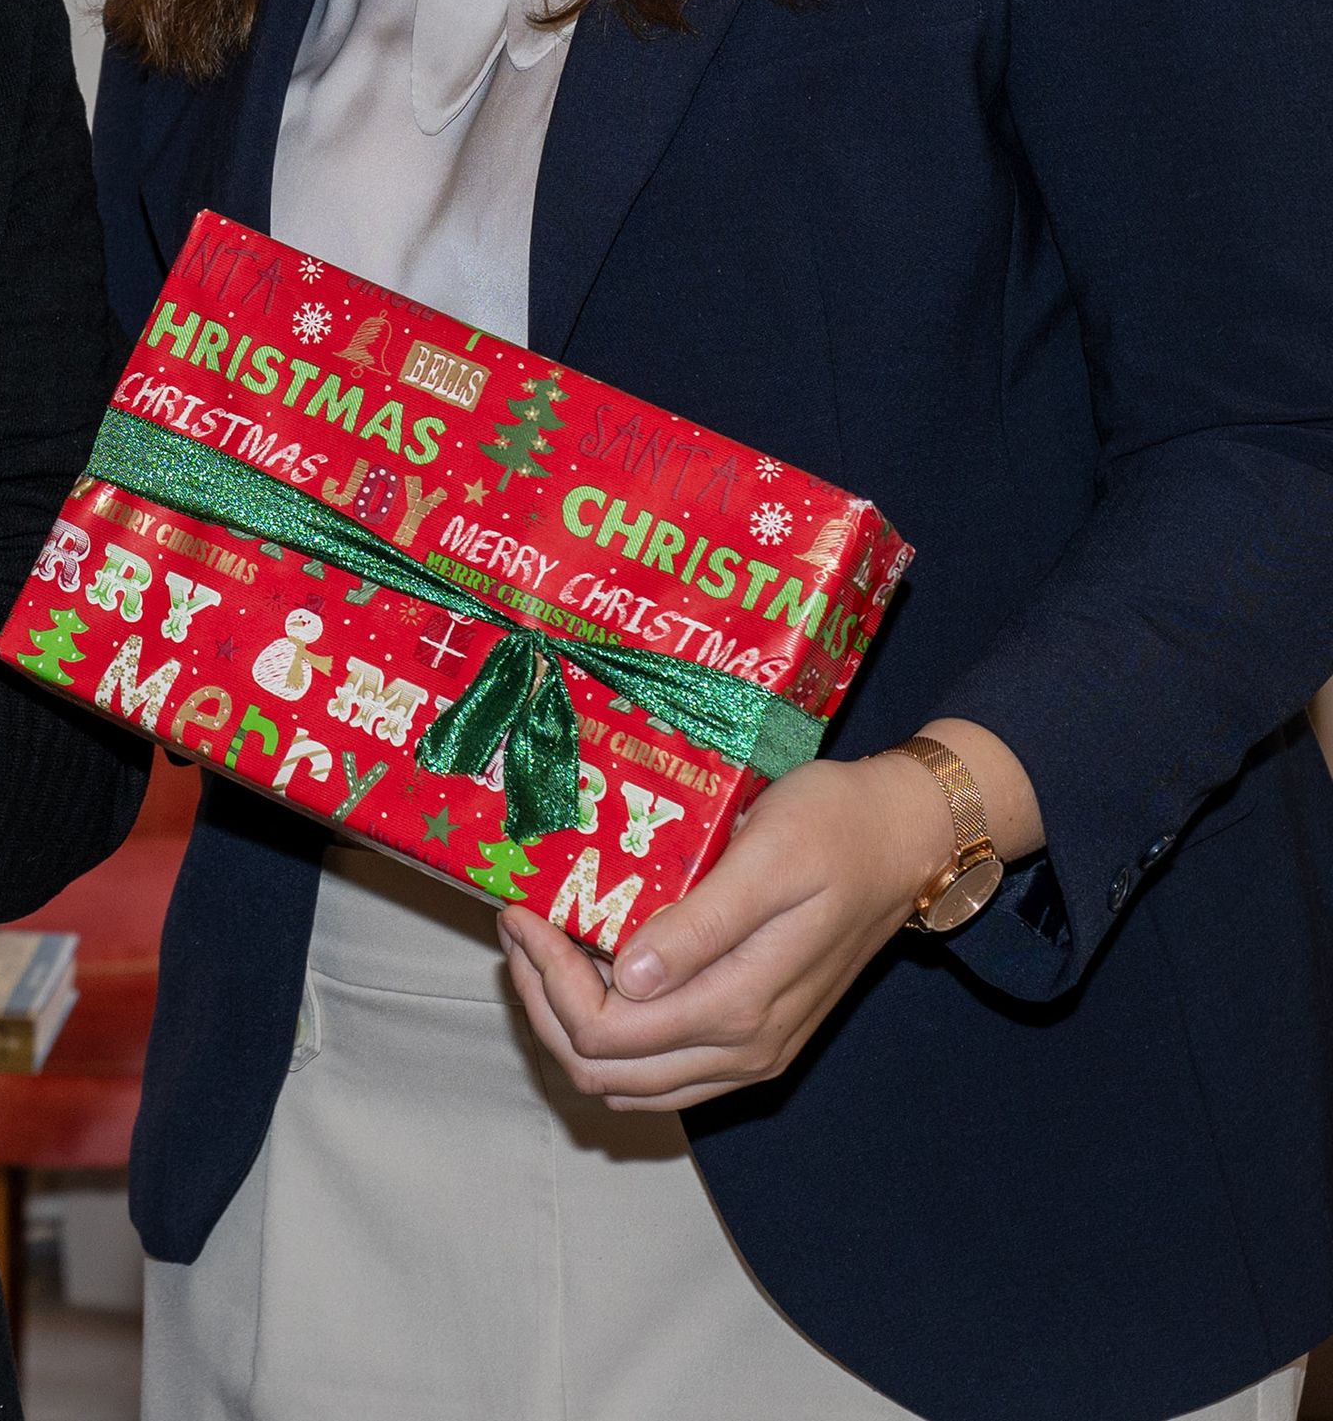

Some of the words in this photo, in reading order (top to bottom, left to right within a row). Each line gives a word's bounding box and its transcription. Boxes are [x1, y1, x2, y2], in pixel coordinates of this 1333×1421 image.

[113, 371, 329, 484] CHRISTMAS
[139, 300, 448, 466] HRISTMAS
[404, 343, 485, 408] BELLS
[321, 457, 448, 547] JOY
[578, 404, 744, 516] SANTA
[93, 492, 157, 537] MERRY
[155, 522, 260, 585] CHRISTMAS
[560, 484, 858, 661] CHRISTMAS
[424, 550, 497, 596] MERRY
[497, 582, 623, 646] CHRISTMAS
[439, 515, 560, 590] MERRY
[558, 572, 790, 687] CHRISTMAS
[94, 634, 390, 824] Merry
[608, 730, 722, 798] CHRISTMAS
